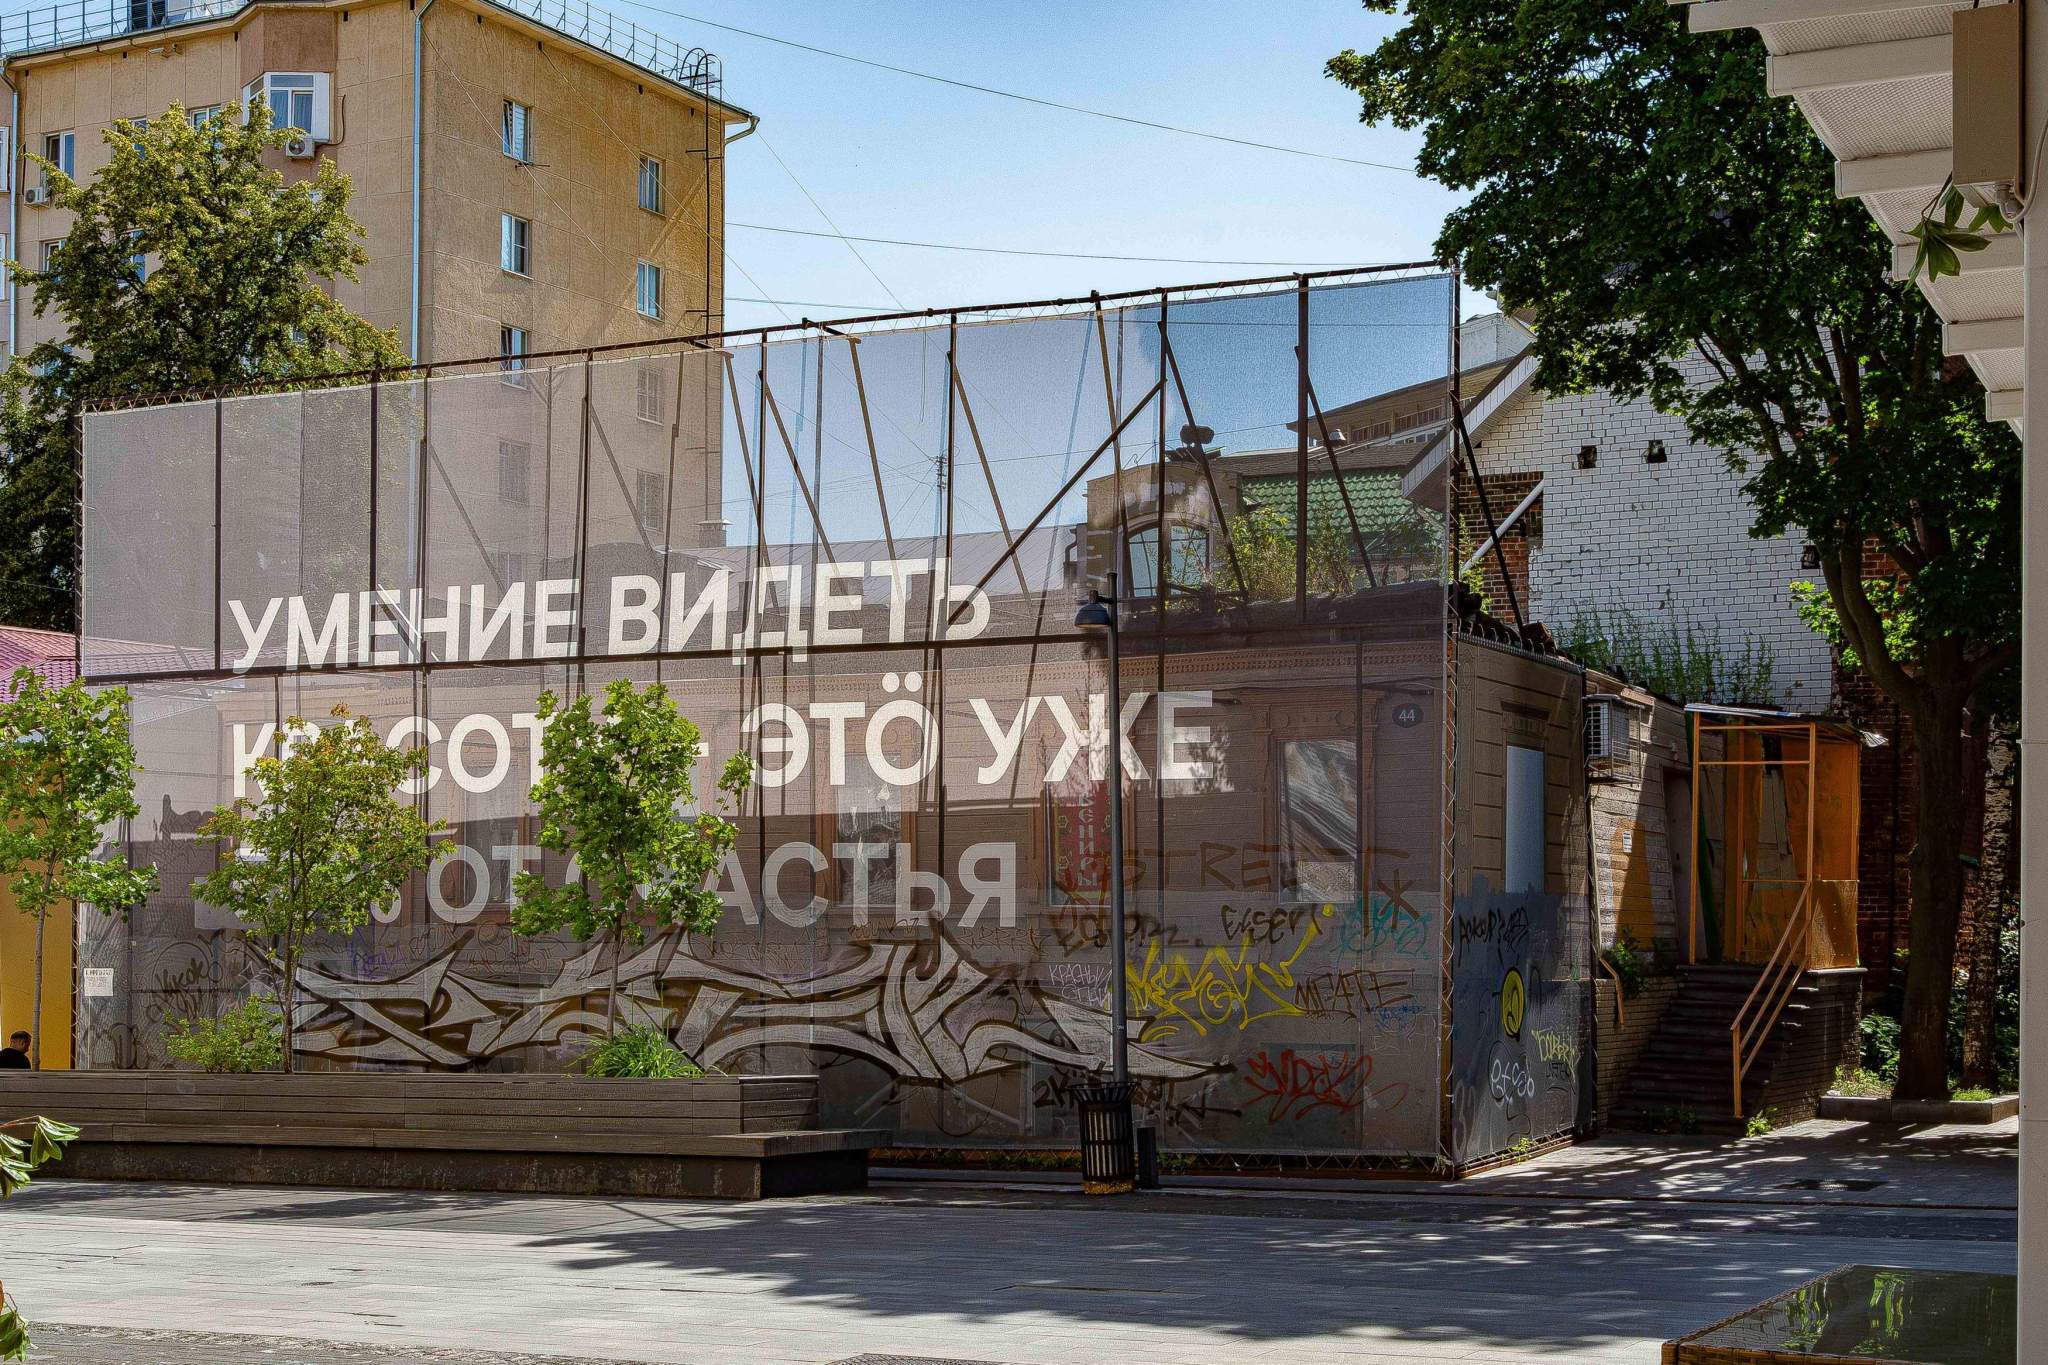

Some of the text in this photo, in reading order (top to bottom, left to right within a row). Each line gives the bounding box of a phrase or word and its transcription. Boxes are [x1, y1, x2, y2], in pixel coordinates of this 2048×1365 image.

[227, 557, 991, 674] УМЕНИЕ ВИДЕТЬ
[969, 690, 1214, 786] УЖЕ
[1398, 708, 1416, 722] 44
